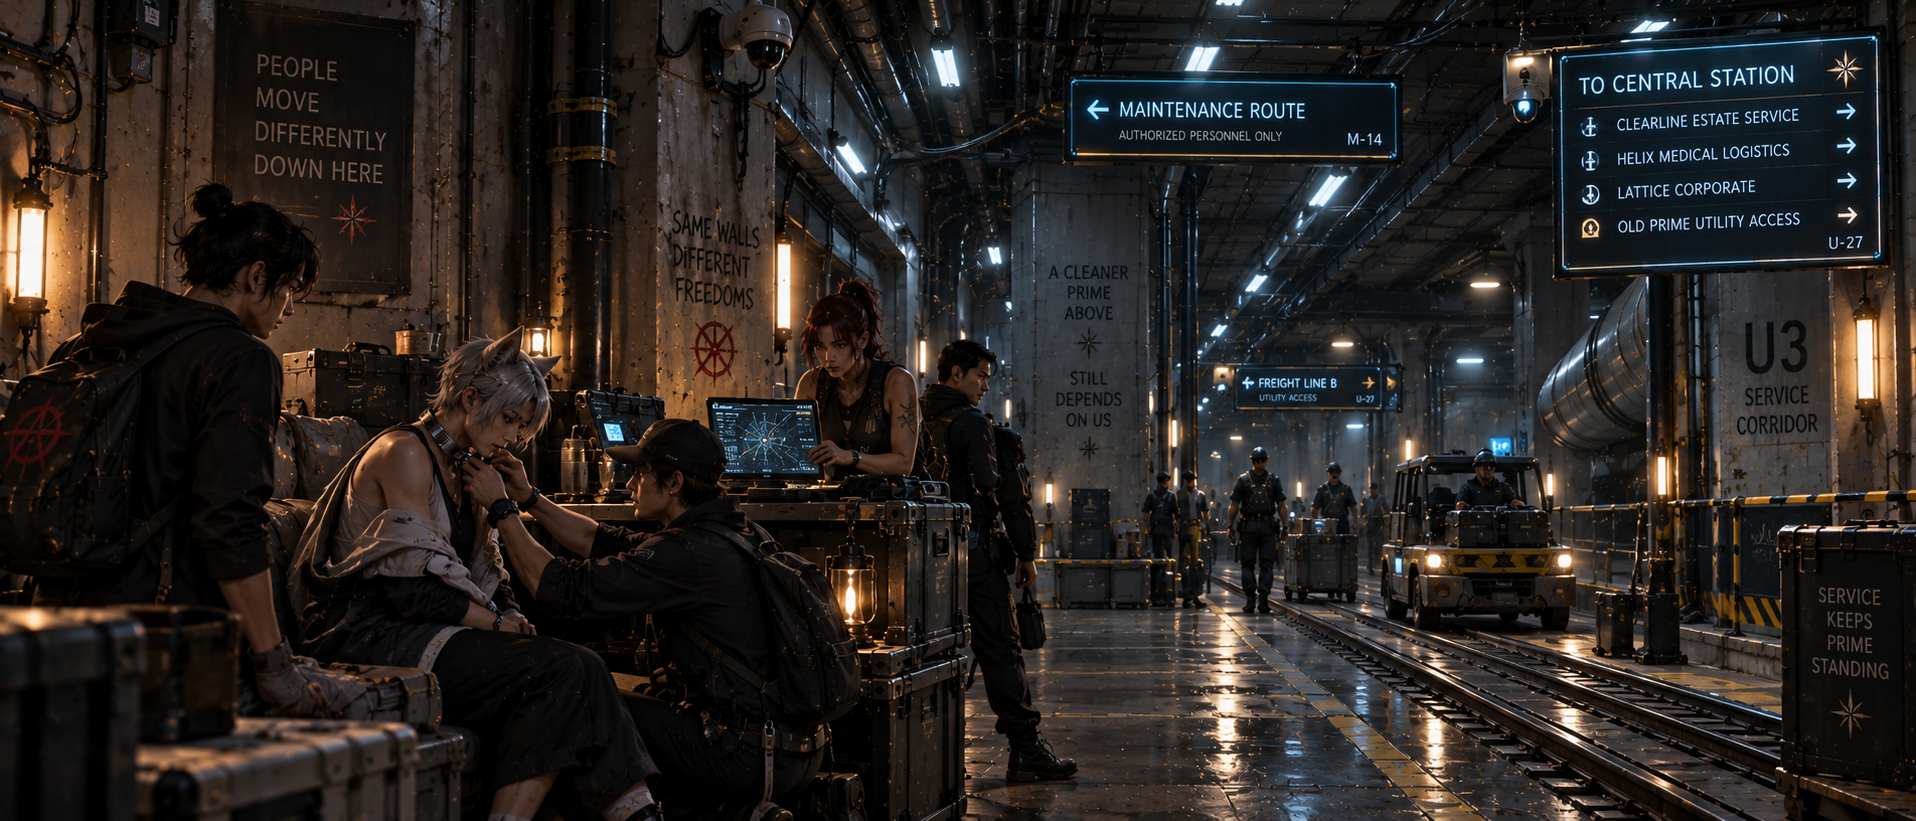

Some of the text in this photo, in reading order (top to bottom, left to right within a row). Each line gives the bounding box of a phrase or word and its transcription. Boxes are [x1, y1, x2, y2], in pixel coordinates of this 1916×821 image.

[257, 53, 337, 81] PEOPLE
[1579, 65, 1794, 95] TO CENTRAL STATION
[256, 87, 319, 113] MOVE
[1119, 101, 1305, 119] MAINTENANCE ROUTE
[1617, 108, 1800, 132] CLEARLINE ESTATE SERVICE
[255, 120, 387, 151] DIFFERENTLY
[1119, 129, 1283, 142] AUTHORIZED PERSONNEL ONLY
[1347, 132, 1383, 146] M-14
[1617, 143, 1790, 166] HELIX MEDICAL LOGISTICS
[254, 153, 383, 184] DOWN HERE
[1617, 180, 1756, 200] LATTICE CORPORATE
[672, 210, 760, 249] SAME WALLS
[1617, 212, 1801, 234] OLD PRIME UTILITY ACCESS
[1828, 235, 1863, 250] U-27
[1048, 265, 1129, 280] A CLEANER
[675, 277, 754, 310] FREEDOMS
[1067, 286, 1111, 300] PRIME
[1064, 306, 1113, 320] ABOVE
[1745, 319, 1808, 374] U3
[1070, 371, 1108, 385] STILL
[1258, 378, 1338, 389] FREIGHT LINE B
[1056, 392, 1122, 407] DEPENDS
[1259, 393, 1318, 402] UTILITY ACCESS
[1745, 385, 1809, 406] SERVICE
[1066, 413, 1111, 427] ON US
[1737, 413, 1818, 435] CORRIDOR
[1819, 586, 1881, 606] SERVICE
[1827, 611, 1873, 630] KEEPS
[1827, 634, 1873, 654] PRIME
[1812, 657, 1889, 680] STANDING
